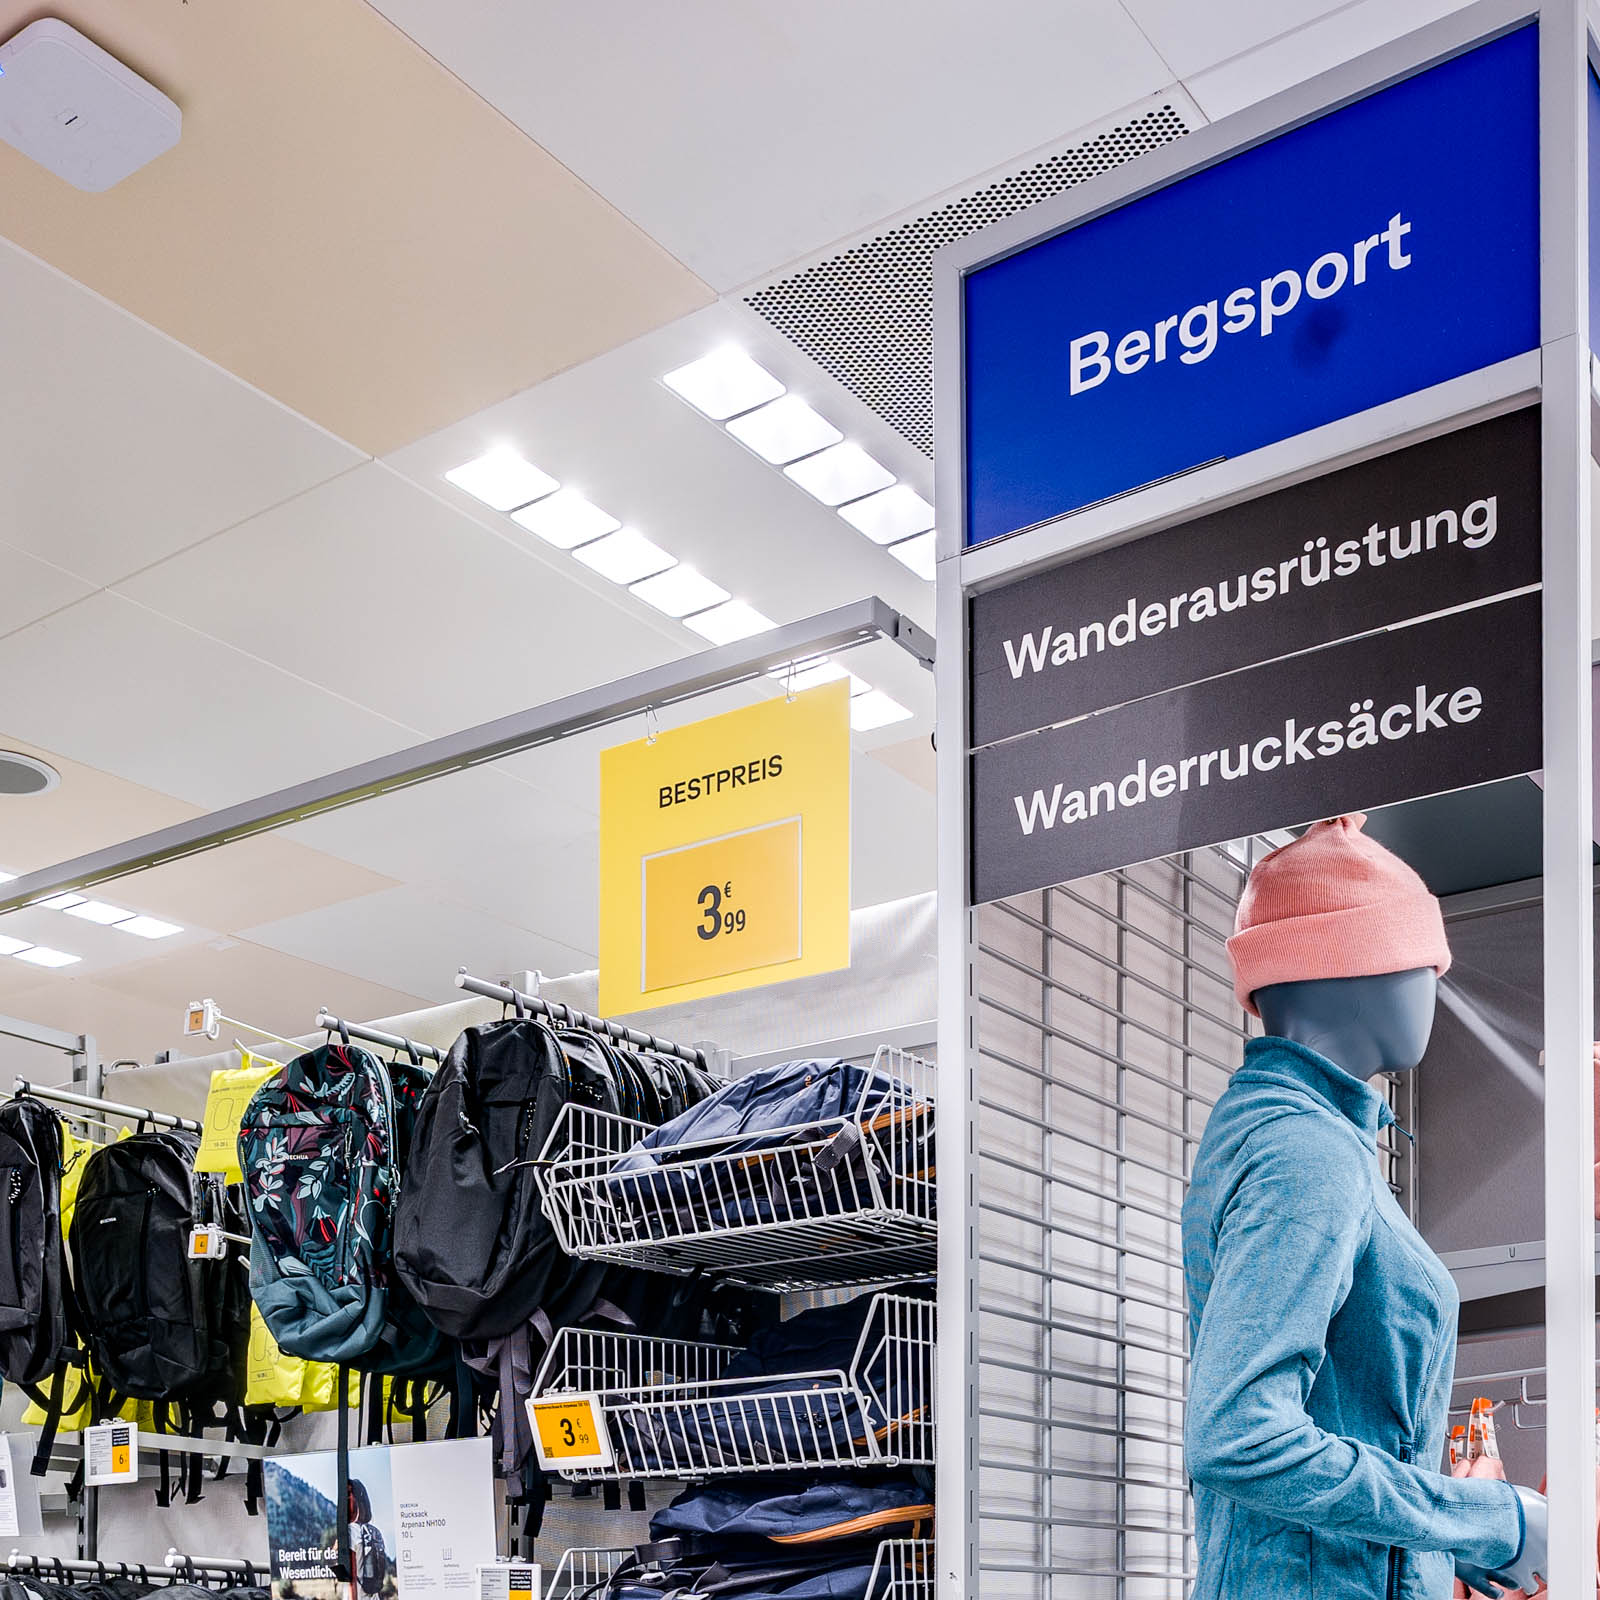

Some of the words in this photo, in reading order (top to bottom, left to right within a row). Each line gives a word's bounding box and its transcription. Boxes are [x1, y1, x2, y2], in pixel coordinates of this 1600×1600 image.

[1070, 213, 1411, 396] Bergsport
[1003, 495, 1498, 679] Wanderausrüstung
[659, 754, 783, 809] BESTPREIS
[1014, 685, 1482, 835] Wanderrucksäcke
[278, 1549, 306, 1562] Bereit
[308, 1548, 322, 1560] für
[401, 1521, 425, 1529] Arpenaz
[426, 1519, 446, 1527] NH100
